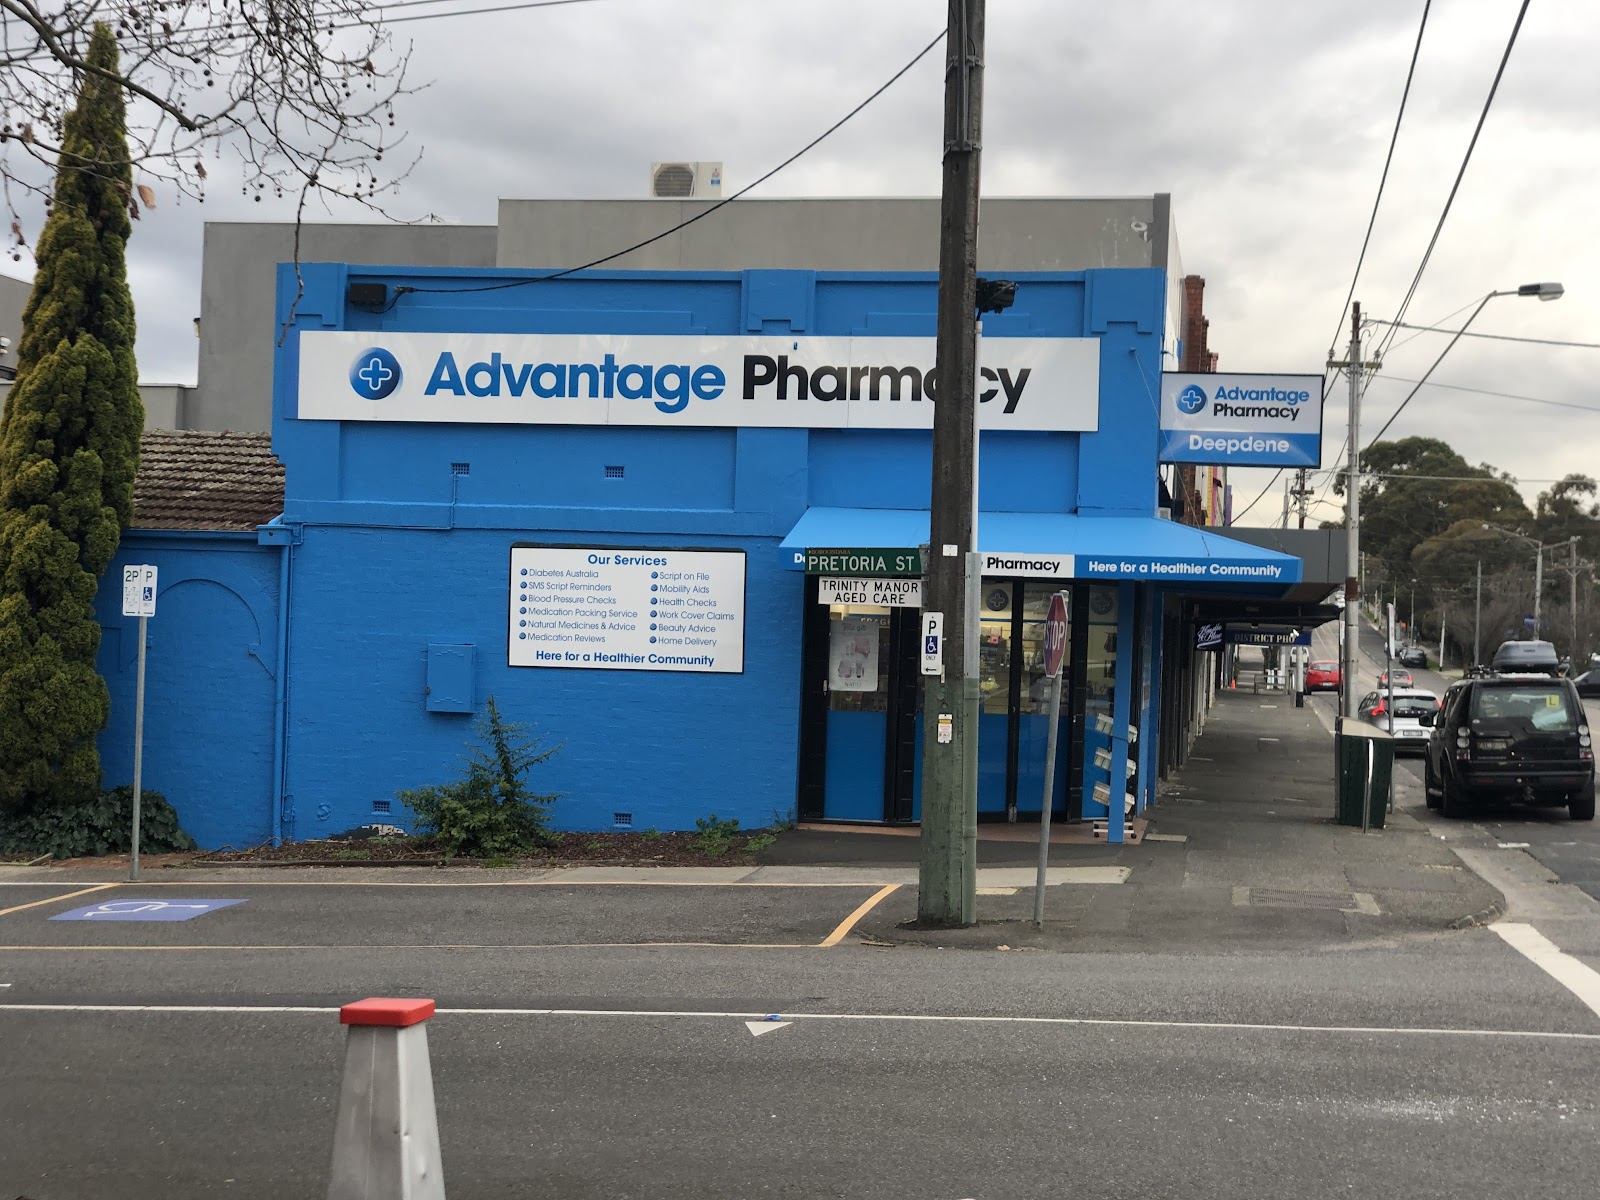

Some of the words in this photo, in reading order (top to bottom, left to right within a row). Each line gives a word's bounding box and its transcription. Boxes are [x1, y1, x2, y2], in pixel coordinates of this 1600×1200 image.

[424, 351, 726, 414] Advantage
[1214, 386, 1310, 406] Advantage
[1213, 403, 1300, 421] Pharmacy
[1188, 434, 1290, 455] Deepdene
[588, 554, 611, 565] Our
[614, 555, 667, 566] Services
[808, 556, 887, 571] PRETORIA
[895, 556, 915, 571] ST
[986, 557, 1061, 574] Pharmacy
[529, 568, 564, 577] Diabetes
[565, 569, 599, 578] Australia
[1088, 561, 1118, 573] Here
[1120, 561, 1136, 573] for
[1138, 563, 1148, 574] a
[1151, 562, 1207, 575] Healthier
[1209, 563, 1282, 579] Community
[125, 570, 139, 583] 2P
[145, 571, 153, 583] P
[659, 572, 682, 581] Script
[696, 572, 710, 581] File
[528, 582, 545, 590] SMS
[546, 582, 569, 592] Script
[569, 583, 612, 591] Reminders
[659, 584, 691, 594] Mobility
[692, 585, 710, 594] Aids
[822, 580, 869, 592] TRINITY
[874, 581, 919, 593] MANOR
[528, 594, 552, 603] Blood
[553, 595, 585, 604] Pressure
[586, 596, 617, 605] Checks
[659, 598, 685, 606] Health
[686, 598, 717, 607] Checks
[834, 592, 867, 604] AGED
[873, 593, 906, 605] CARE
[528, 607, 574, 616] Medication
[575, 608, 607, 618] Packing
[608, 609, 638, 618] Service
[658, 610, 679, 619] Work
[680, 611, 705, 619] Cover
[706, 611, 735, 620] Claims
[528, 620, 557, 629] Natural
[558, 621, 599, 630] Medicines
[600, 622, 607, 630] &
[608, 622, 636, 631] Advice
[658, 623, 687, 633] Beauty
[688, 624, 716, 633] Advice
[928, 620, 937, 634] P
[527, 633, 573, 642] Medication
[574, 634, 606, 643] Reviews
[1045, 620, 1065, 651] STOP
[1234, 633, 1275, 643] DISTRICT
[1276, 634, 1296, 644] PHO
[658, 637, 683, 645] Home
[684, 637, 718, 647] Delivery
[536, 650, 562, 661] Here
[565, 651, 580, 661] for
[582, 653, 591, 662] a
[594, 652, 646, 663] Healthier
[648, 653, 715, 667] Community
[1549, 696, 1557, 706] L
